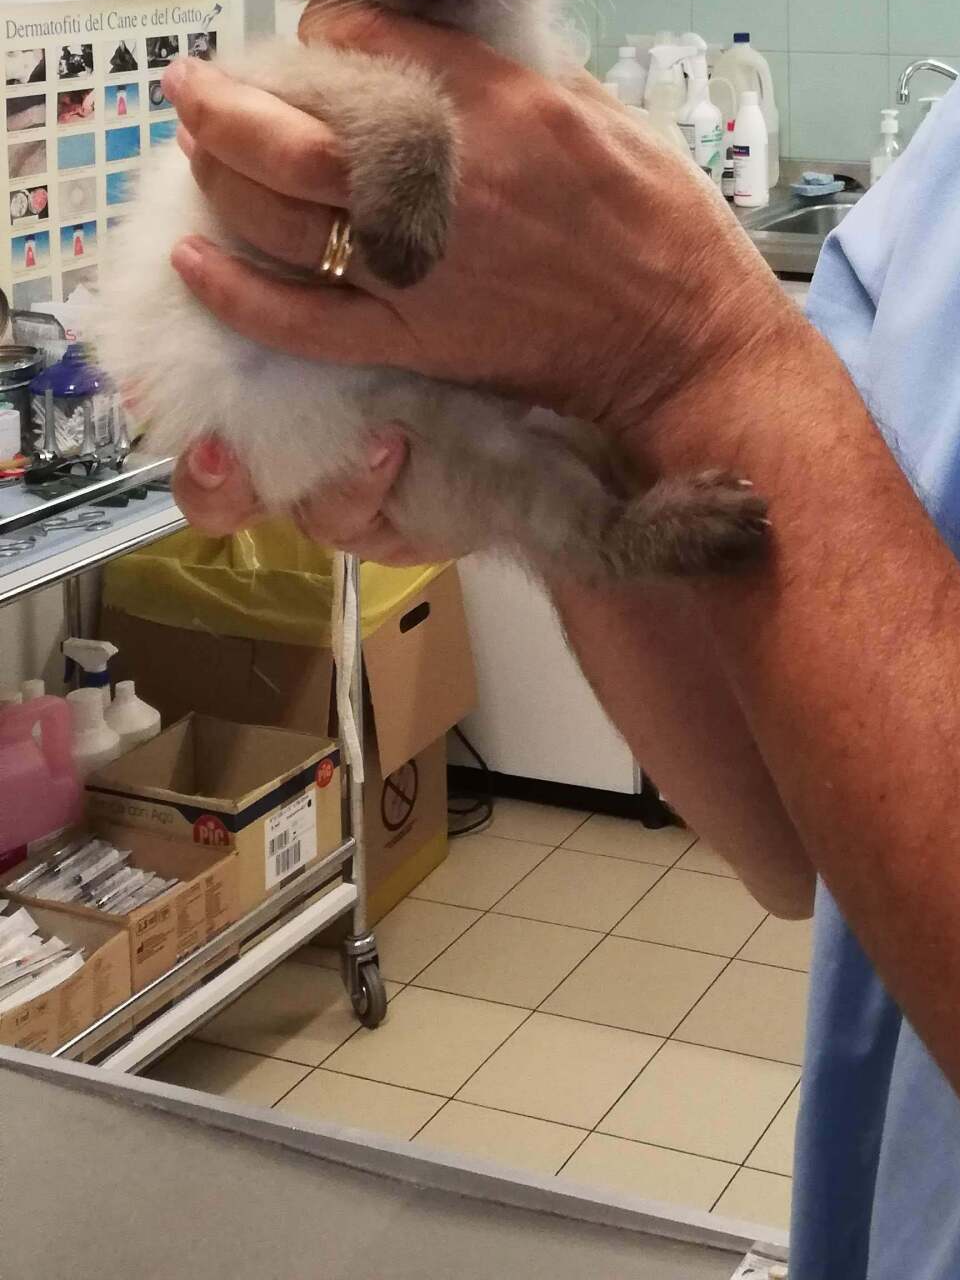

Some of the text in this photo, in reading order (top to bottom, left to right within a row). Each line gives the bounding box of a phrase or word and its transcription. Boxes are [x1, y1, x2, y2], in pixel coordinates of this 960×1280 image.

[6, 5, 202, 39] Dermatofiti del Cane e del Gatto
